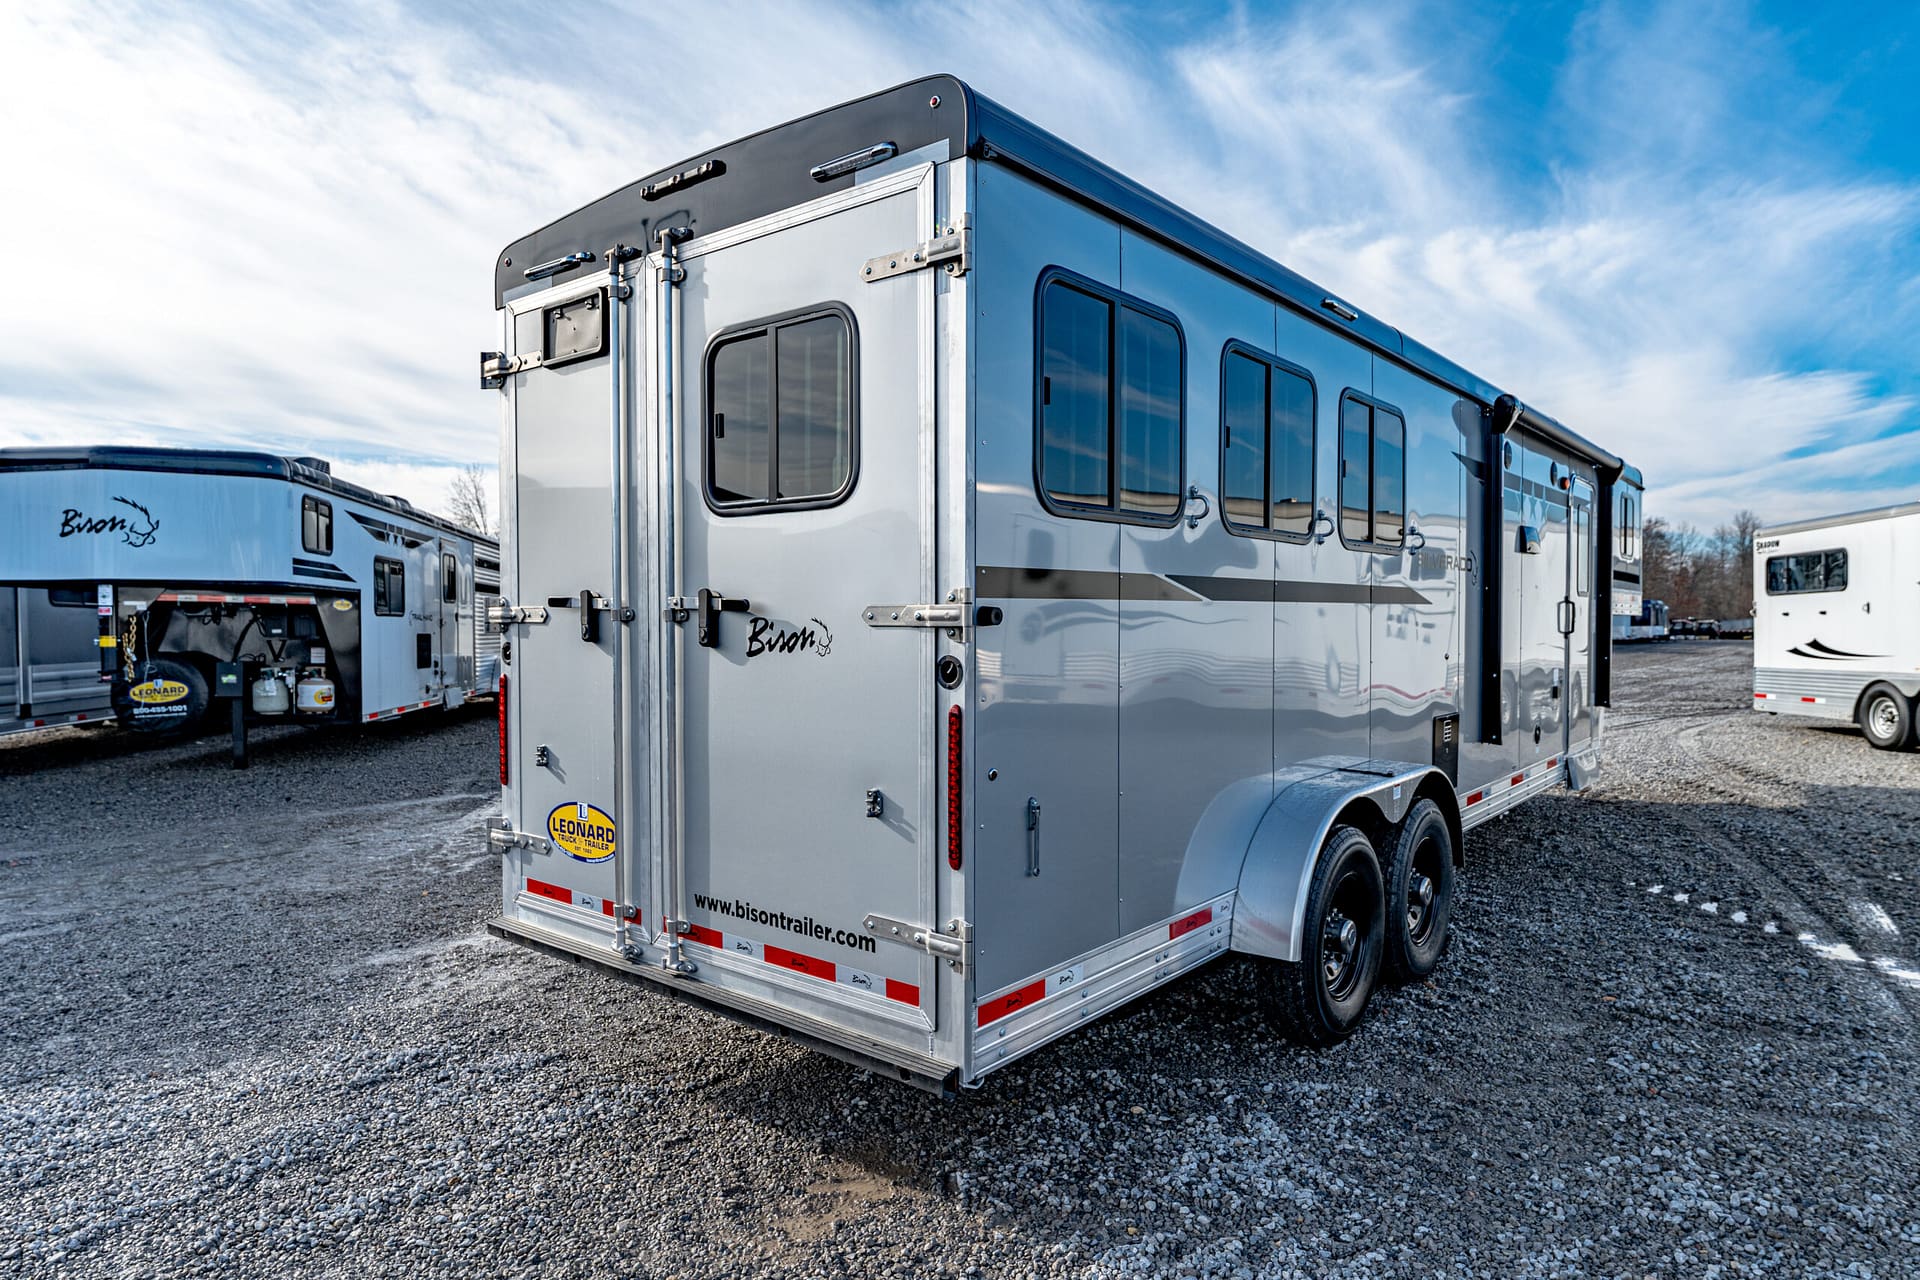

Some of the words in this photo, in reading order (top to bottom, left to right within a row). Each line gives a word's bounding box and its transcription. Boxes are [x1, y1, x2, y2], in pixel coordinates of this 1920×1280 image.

[60, 509, 127, 537] Bison
[746, 617, 816, 657] Bison
[132, 686, 185, 697] LEONARD
[552, 816, 615, 843] LEONARD
[558, 833, 577, 844] TRUCK
[584, 839, 609, 850] TRAILER
[694, 894, 876, 953] www.bisontrailer.com
